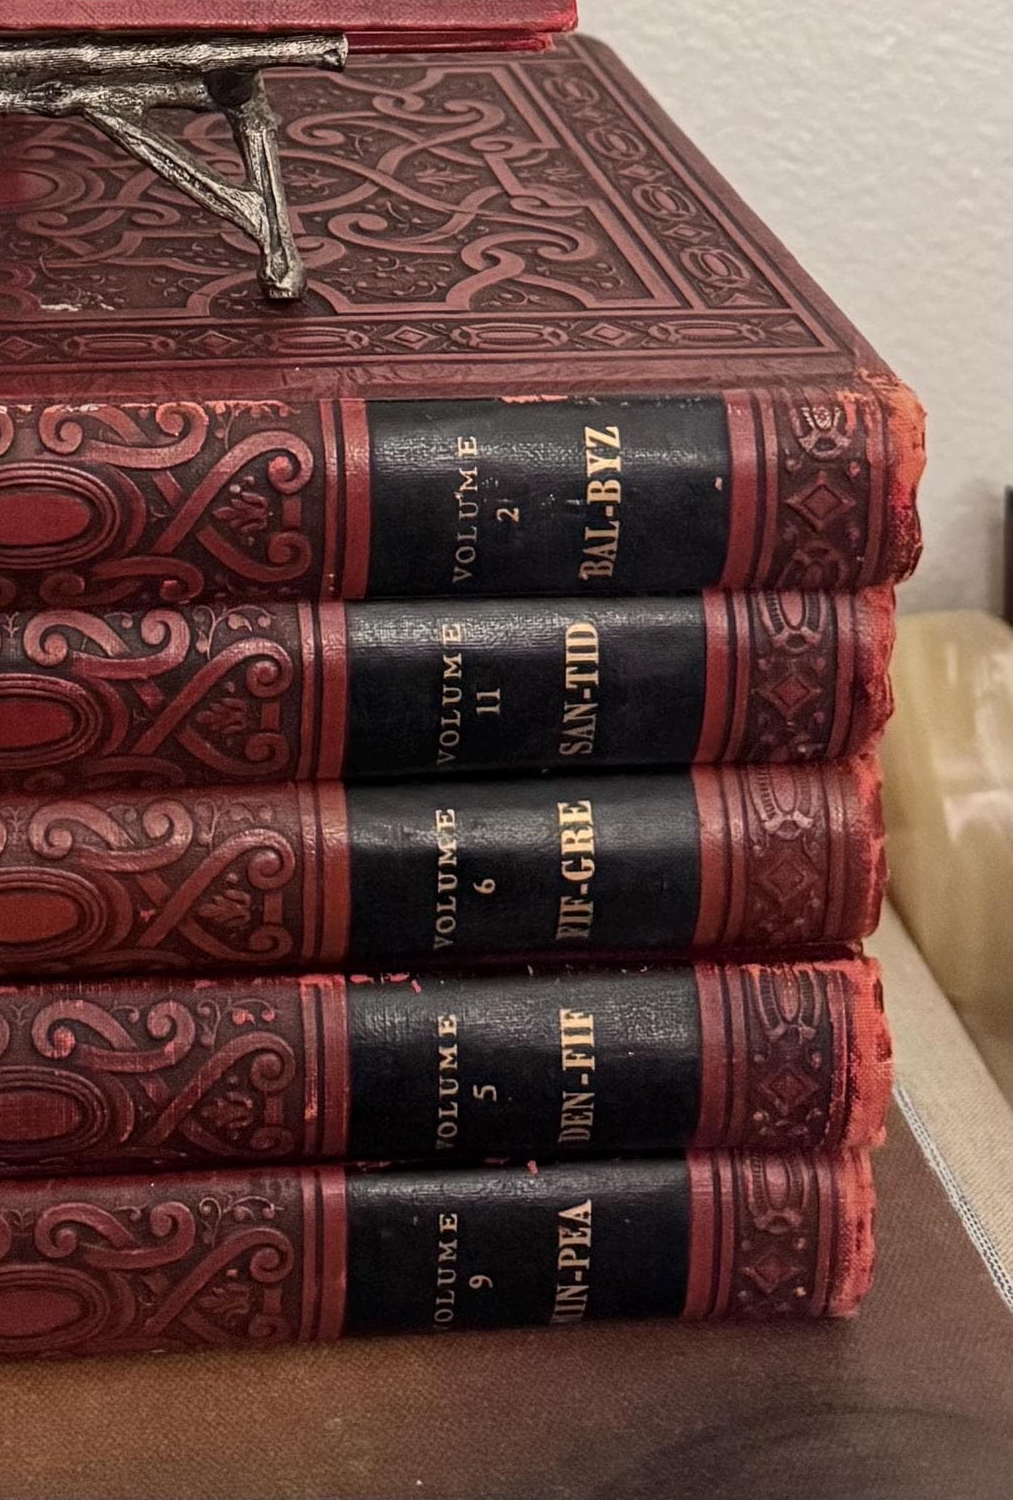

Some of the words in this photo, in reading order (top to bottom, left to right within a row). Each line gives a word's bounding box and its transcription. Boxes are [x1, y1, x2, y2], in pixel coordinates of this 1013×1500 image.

[452, 436, 479, 583] VOLUME
[496, 507, 521, 524] 2
[578, 426, 621, 580] BAL-BYZ
[437, 623, 462, 765] VOLUME
[476, 687, 501, 716] 11
[559, 621, 599, 756] SAN-TID
[433, 808, 457, 949] VOLUME
[473, 878, 496, 895] 6
[473, 1084, 497, 1102] 5
[434, 1212, 458, 1330] OLUME
[469, 1274, 493, 1290] 9
